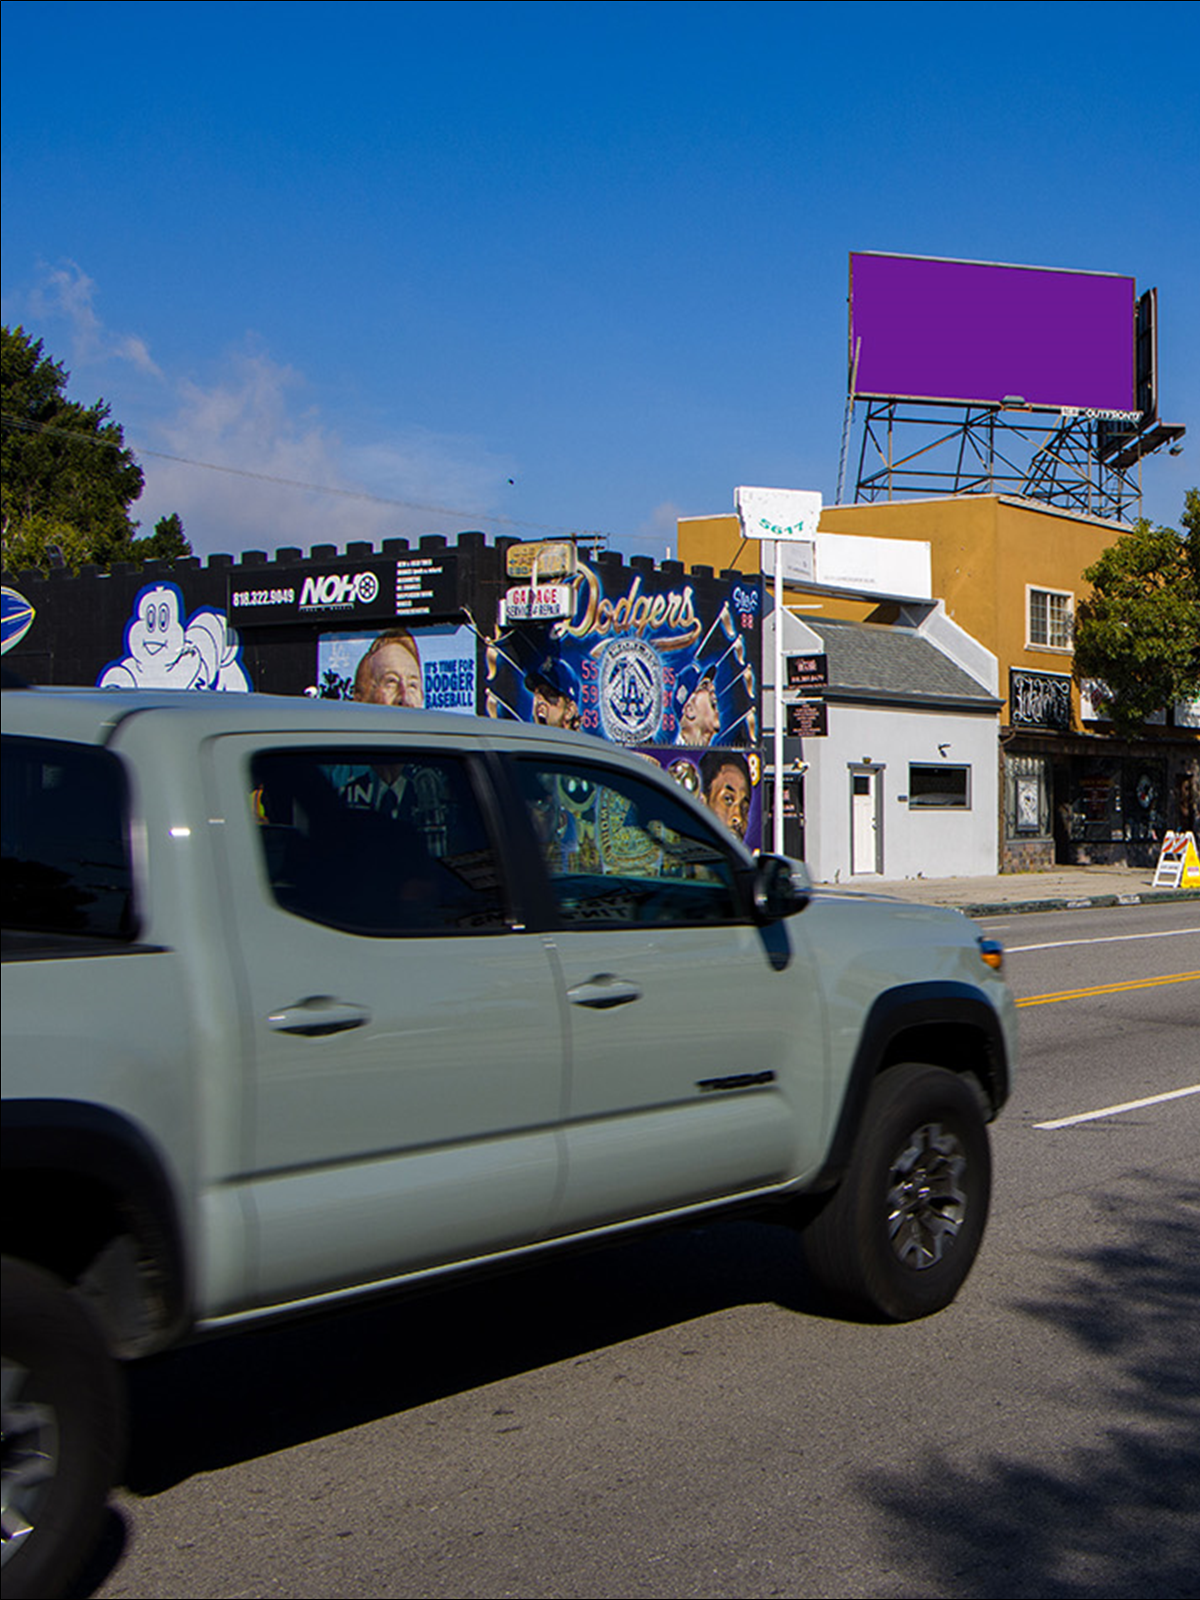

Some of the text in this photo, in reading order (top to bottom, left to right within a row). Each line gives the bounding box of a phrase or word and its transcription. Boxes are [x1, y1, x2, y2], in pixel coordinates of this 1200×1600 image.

[759, 518, 804, 535] 5617
[513, 588, 557, 605] GAAGE
[550, 561, 701, 645] Dodgers
[458, 659, 475, 672] FOR
[581, 660, 599, 680] 55
[424, 672, 475, 692] DODGER
[424, 692, 474, 709] BASEBALL
[582, 684, 599, 703] 59
[583, 708, 599, 728] 63
